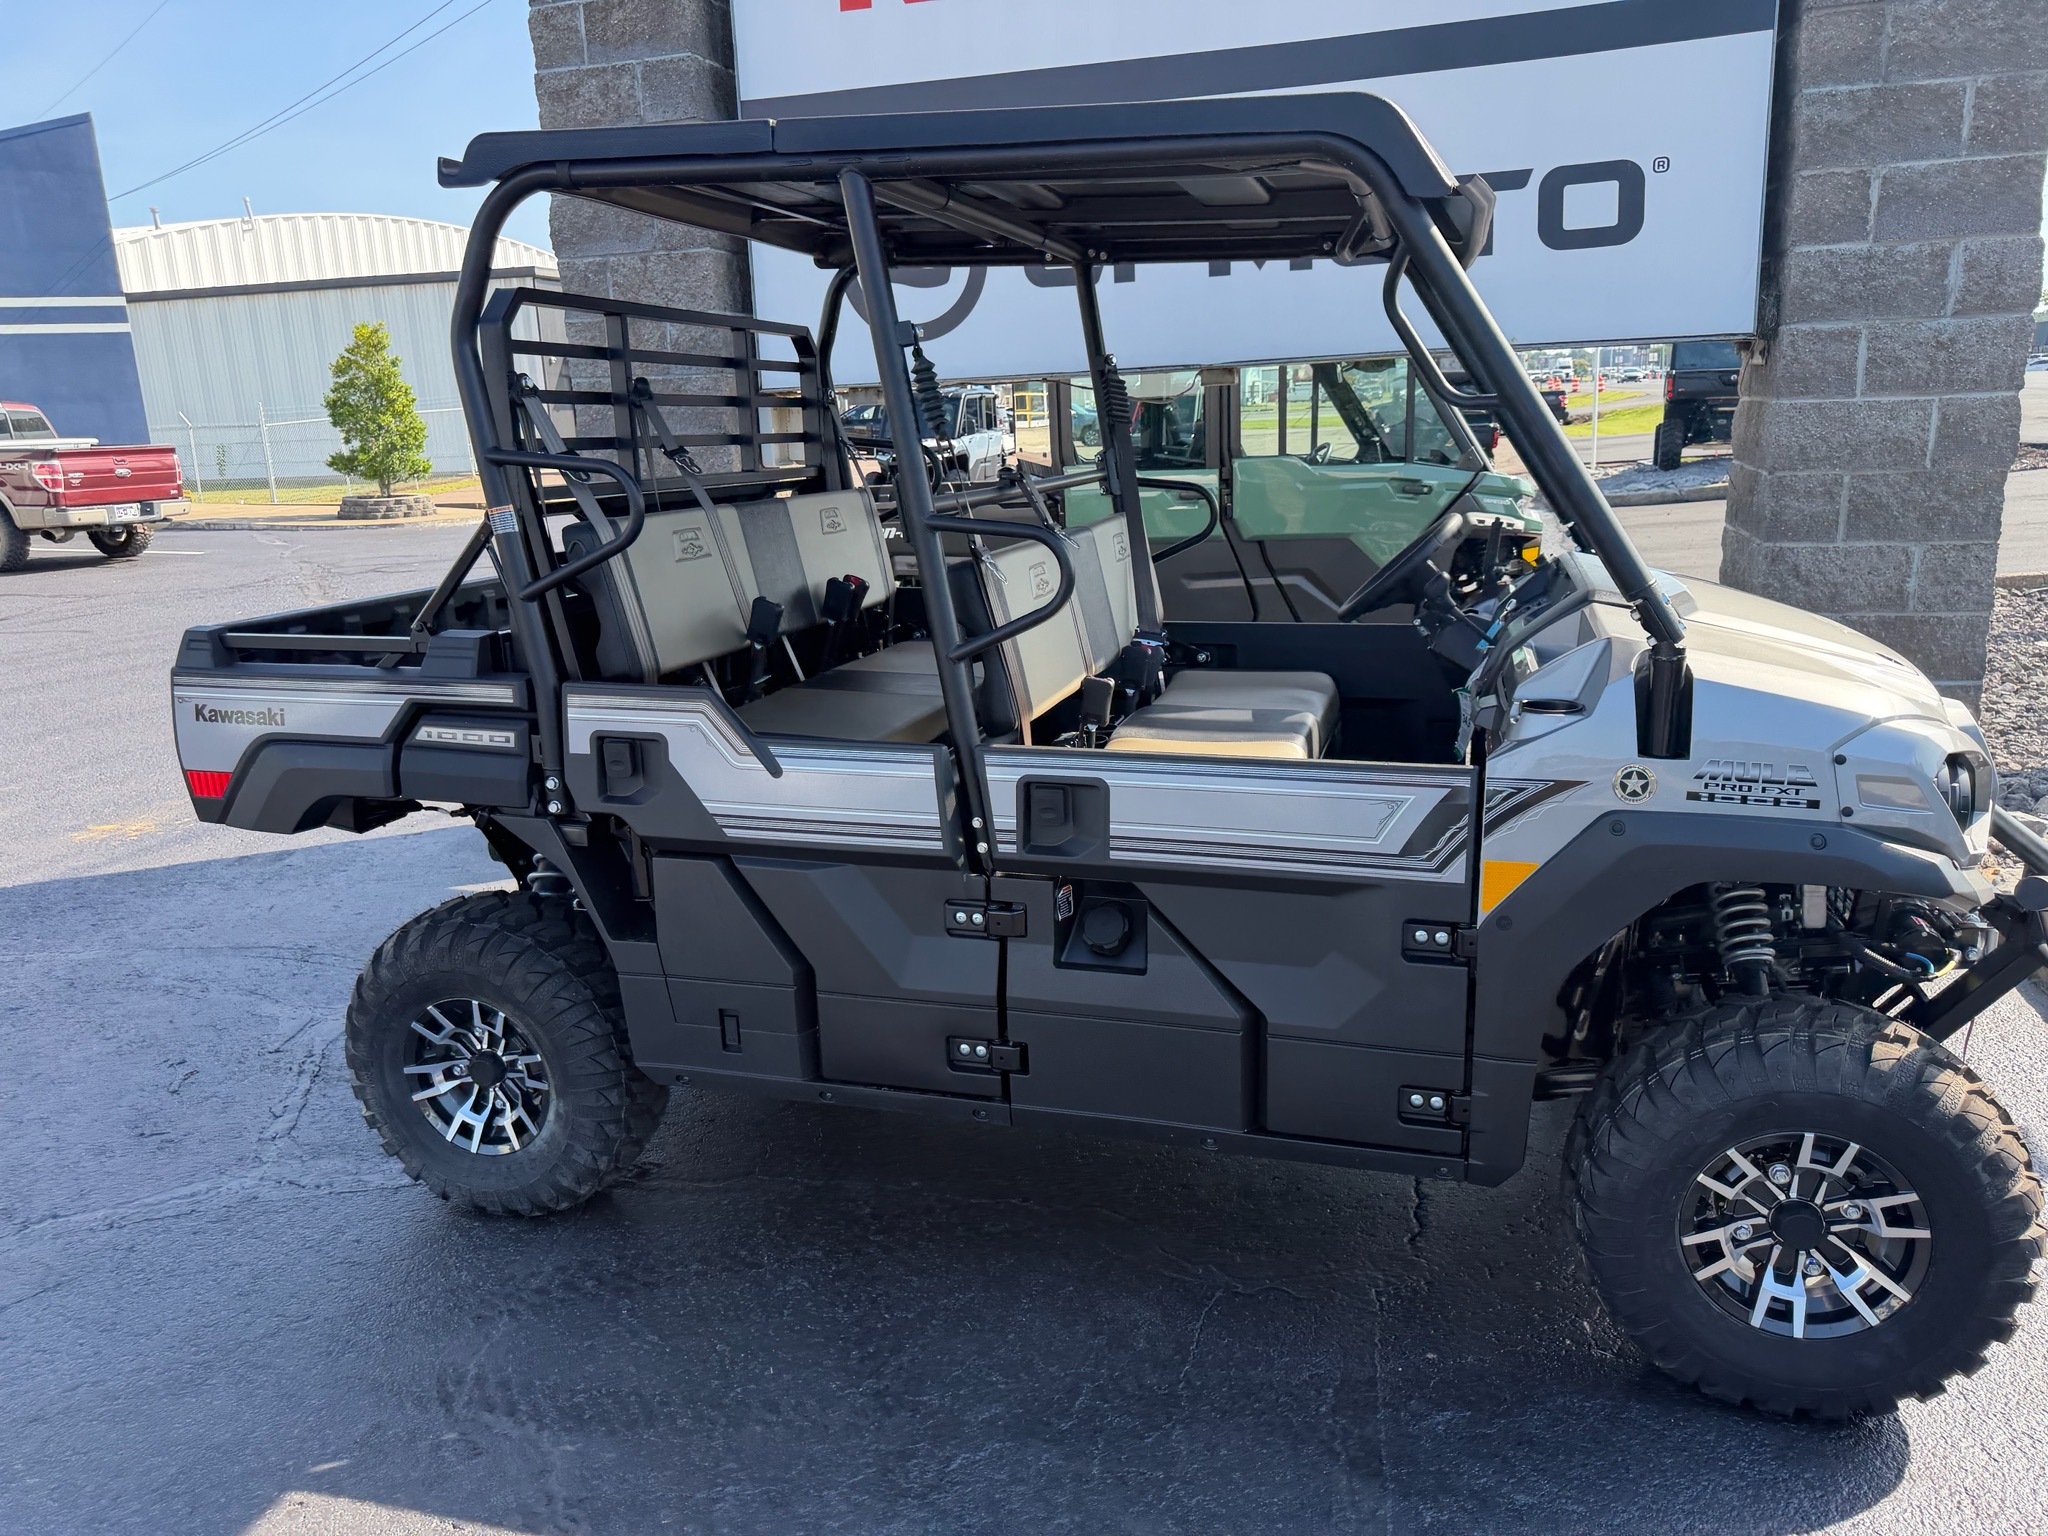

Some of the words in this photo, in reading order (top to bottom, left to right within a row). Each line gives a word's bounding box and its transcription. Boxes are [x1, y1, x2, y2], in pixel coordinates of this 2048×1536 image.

[194, 703, 286, 726] Kawasaki
[424, 730, 511, 744] 1000
[1693, 759, 1818, 788] MULE
[1703, 782, 1806, 796] PRO-FXT
[1699, 792, 1808, 808] 1000
